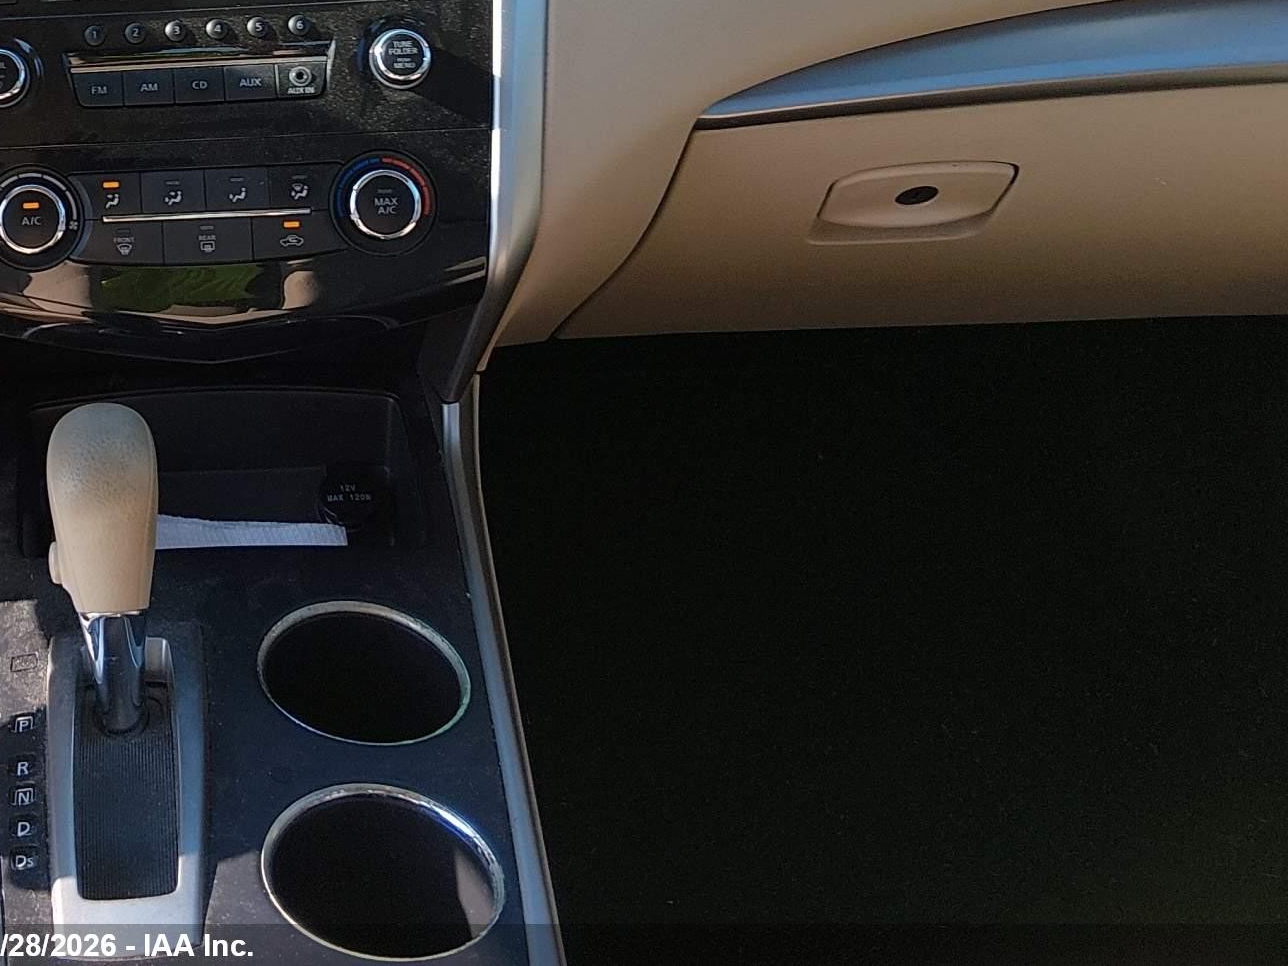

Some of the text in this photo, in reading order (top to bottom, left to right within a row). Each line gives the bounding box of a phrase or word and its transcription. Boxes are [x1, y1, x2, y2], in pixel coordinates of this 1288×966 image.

[92, 19, 304, 40] 1 2 3 4 5 6
[388, 47, 418, 55] FOLDER
[91, 77, 263, 96] FM AM CD AUX
[374, 197, 399, 207] MAX
[377, 206, 397, 215] A/C
[21, 216, 42, 226] A/C
[19, 719, 30, 732] P
[17, 761, 30, 776] R
[18, 790, 30, 804] N
[16, 821, 31, 838] D
